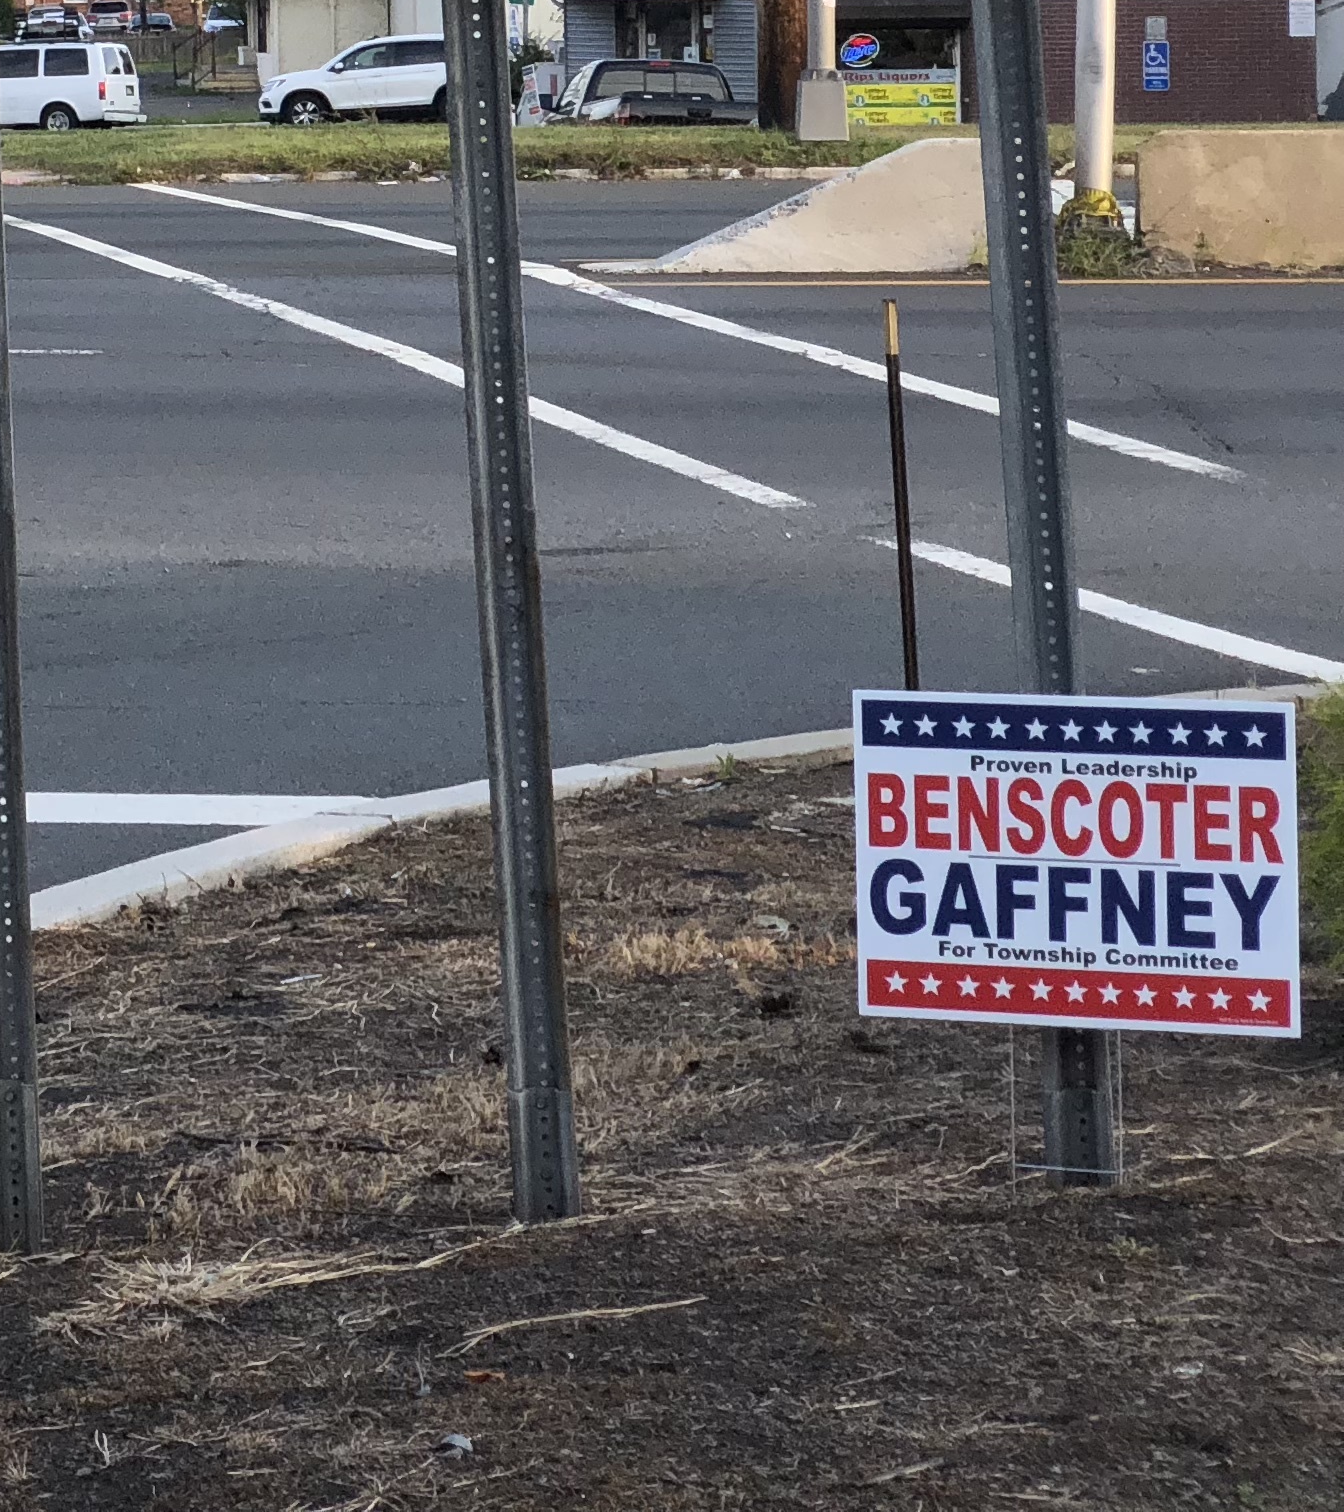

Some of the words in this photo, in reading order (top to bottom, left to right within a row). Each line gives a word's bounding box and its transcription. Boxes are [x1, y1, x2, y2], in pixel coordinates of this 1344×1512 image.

[878, 72, 931, 83] Liquors
[970, 755, 1053, 775] Proven
[1061, 757, 1198, 784] Leadership
[867, 772, 1284, 865] BENSCOTER
[869, 858, 1281, 952] GAFFNEY
[938, 940, 976, 960] For
[982, 943, 1098, 968] Township
[1105, 949, 1239, 972] Committee
